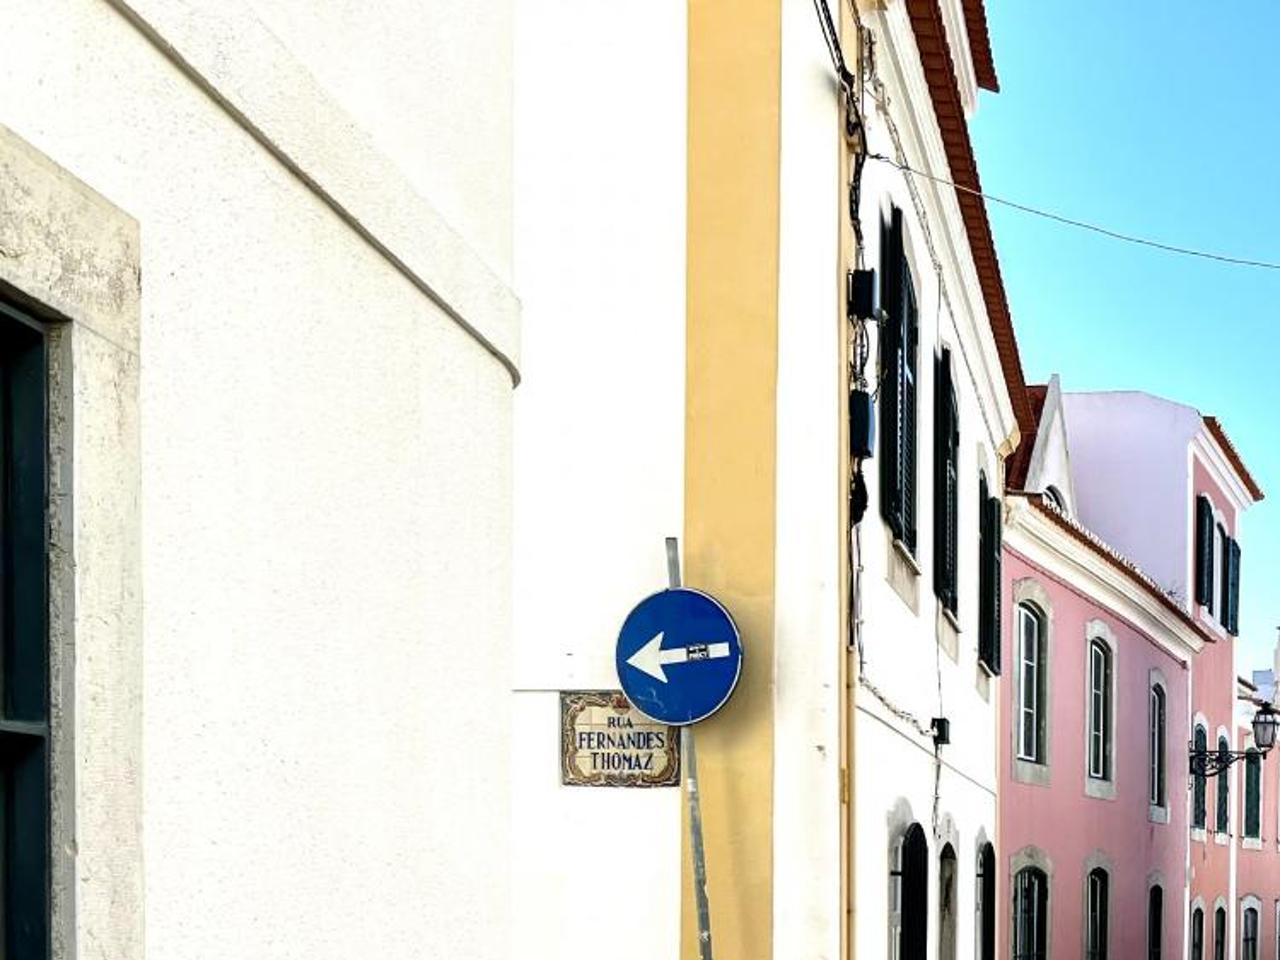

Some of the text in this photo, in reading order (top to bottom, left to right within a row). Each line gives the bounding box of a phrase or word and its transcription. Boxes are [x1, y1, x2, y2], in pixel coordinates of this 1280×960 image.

[607, 717, 633, 729] RUA
[579, 731, 665, 750] FERNANDES
[591, 752, 654, 770] THOMAZ
